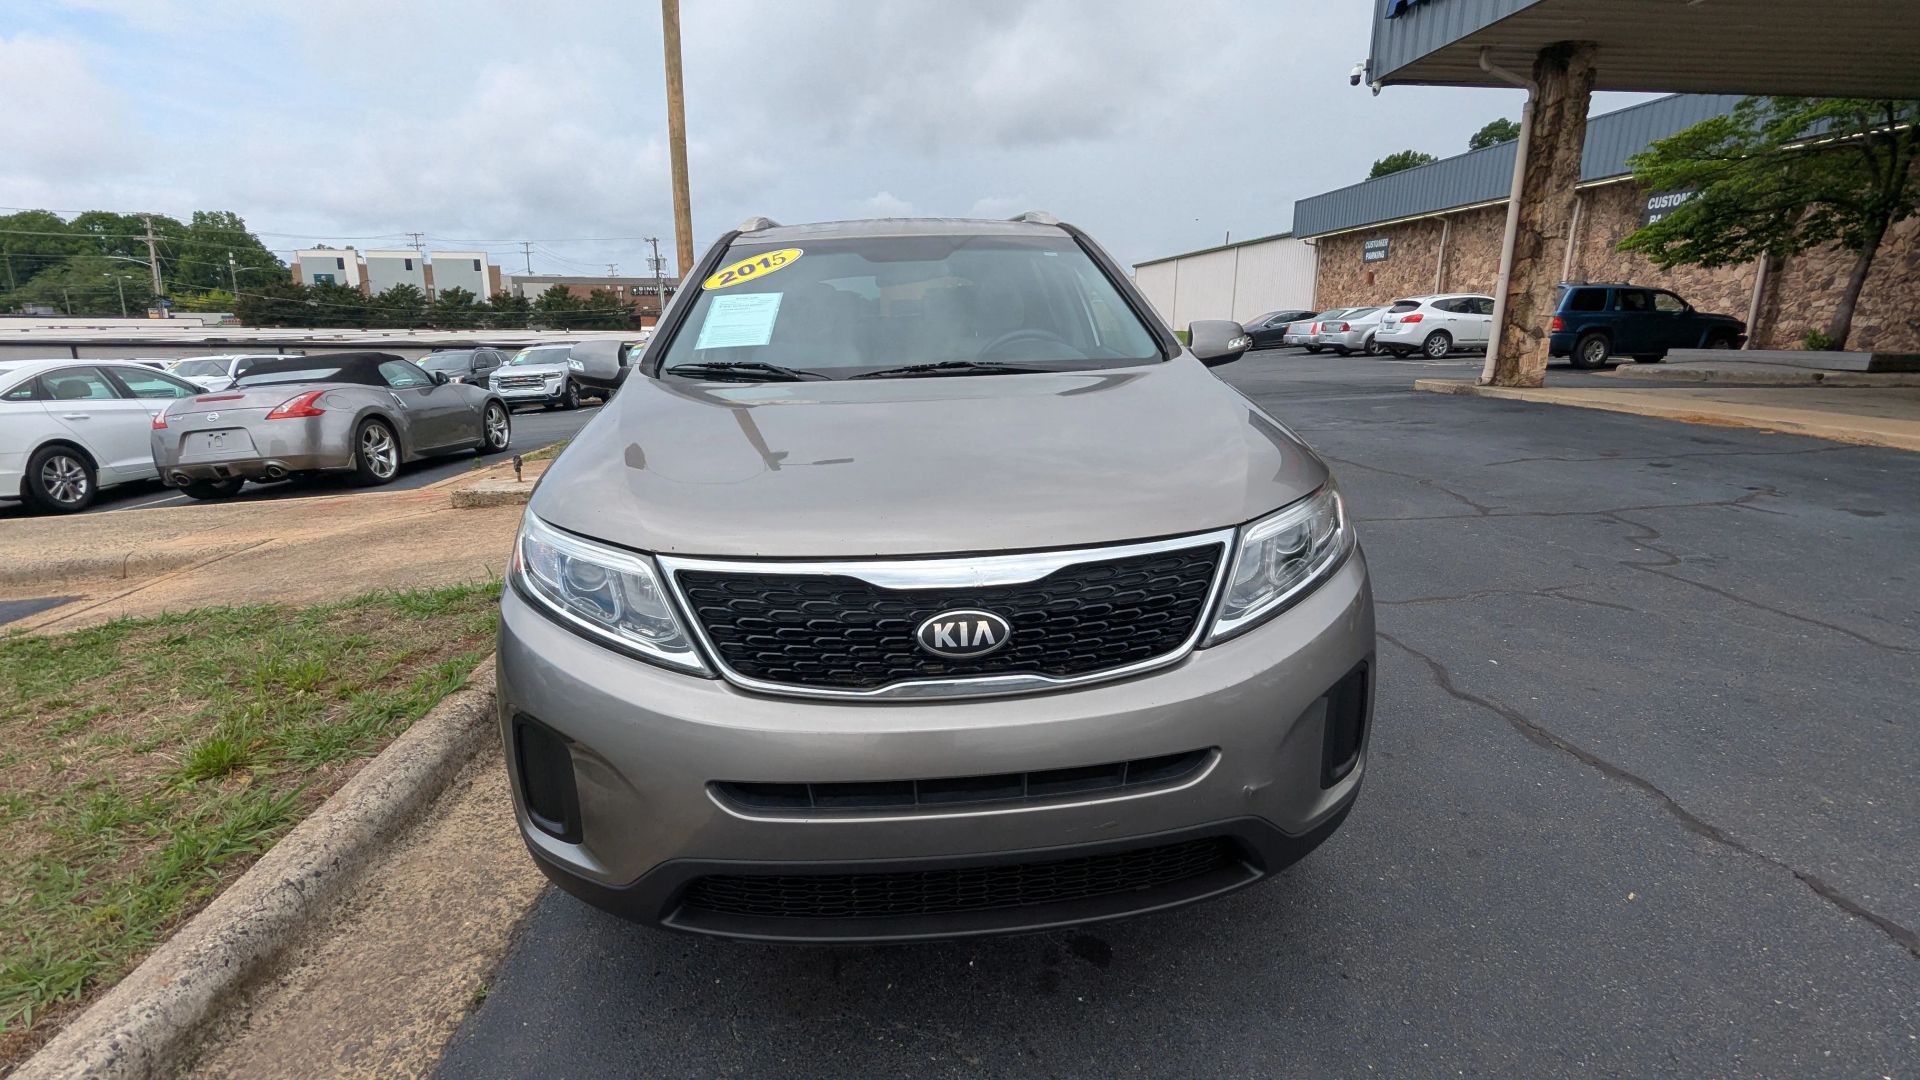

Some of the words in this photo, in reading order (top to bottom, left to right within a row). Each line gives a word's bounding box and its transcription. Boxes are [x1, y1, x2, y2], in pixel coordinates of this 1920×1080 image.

[1647, 192, 1706, 210] CUSTOM
[1364, 238, 1389, 249] CUSTOMER
[1365, 250, 1385, 260] PARKING
[718, 252, 786, 285] 2015
[933, 620, 996, 648] KIA
